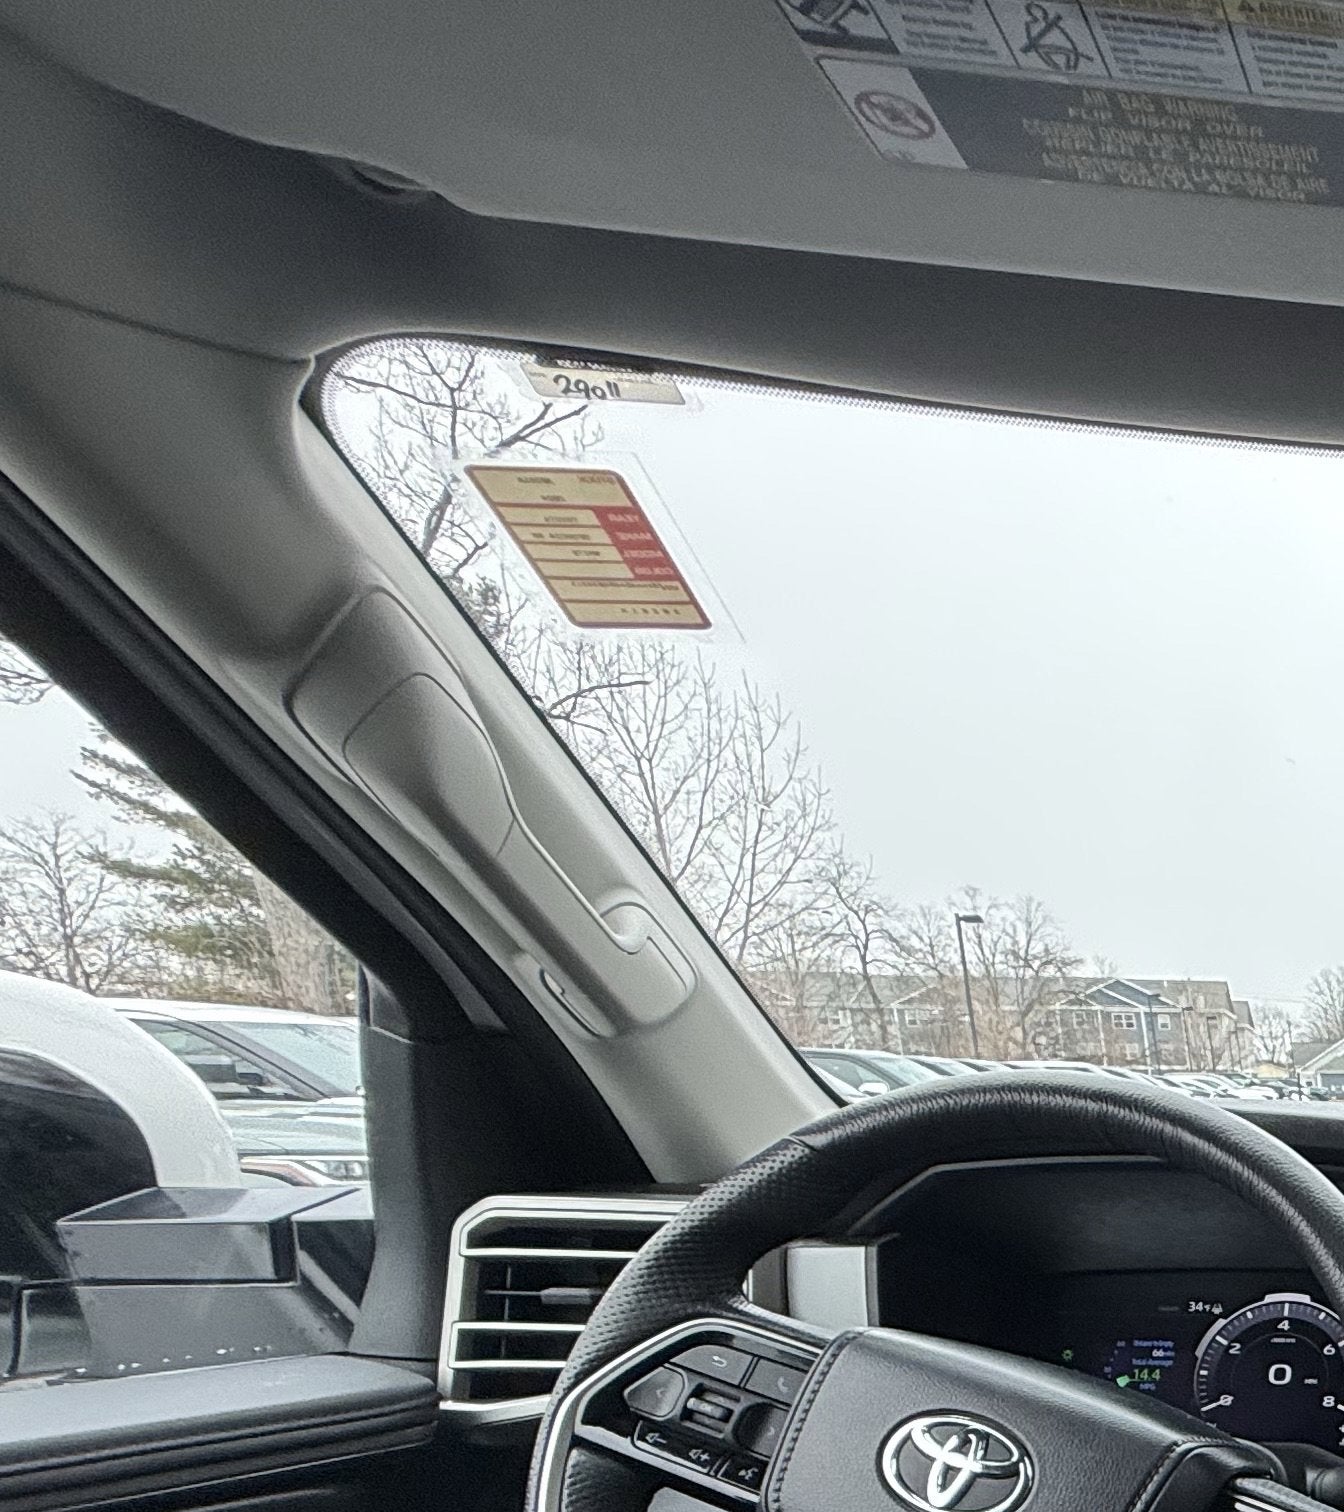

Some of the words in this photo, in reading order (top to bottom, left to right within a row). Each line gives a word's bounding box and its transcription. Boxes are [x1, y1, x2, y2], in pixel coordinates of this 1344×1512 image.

[1276, 1320, 1291, 1331] 4
[1152, 1348, 1164, 1357] 66
[1228, 1342, 1241, 1354] 2
[1323, 1344, 1336, 1355] 6
[1133, 1368, 1161, 1381] 14.4
[1268, 1364, 1292, 1386] 0
[1322, 1395, 1335, 1407] 8
